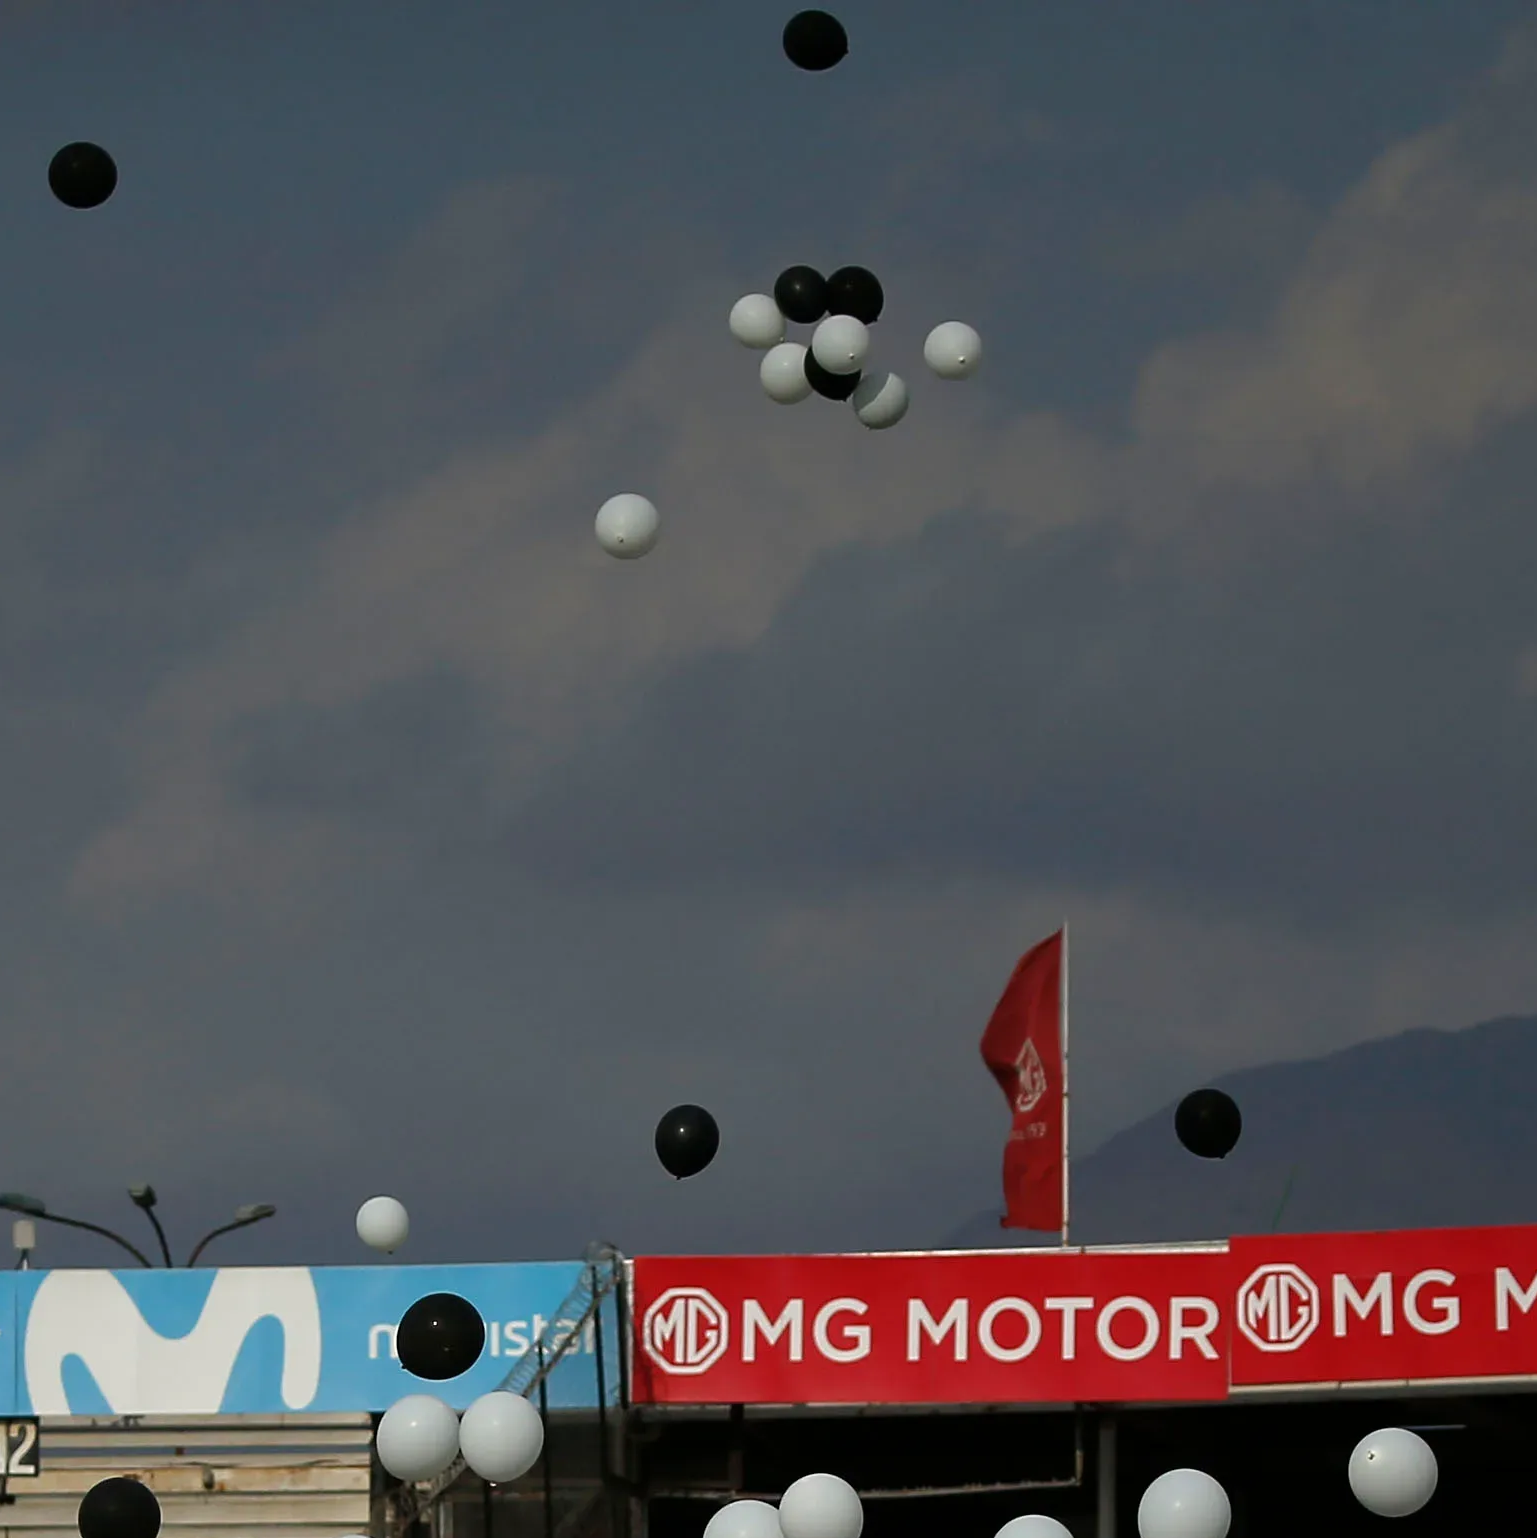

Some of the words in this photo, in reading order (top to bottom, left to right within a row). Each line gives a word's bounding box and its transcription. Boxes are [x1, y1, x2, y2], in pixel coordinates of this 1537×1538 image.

[368, 1313, 597, 1360] mistar
[741, 1296, 872, 1363] MG
[906, 1295, 1222, 1362] MOTOR
[1332, 1269, 1461, 1338] MG
